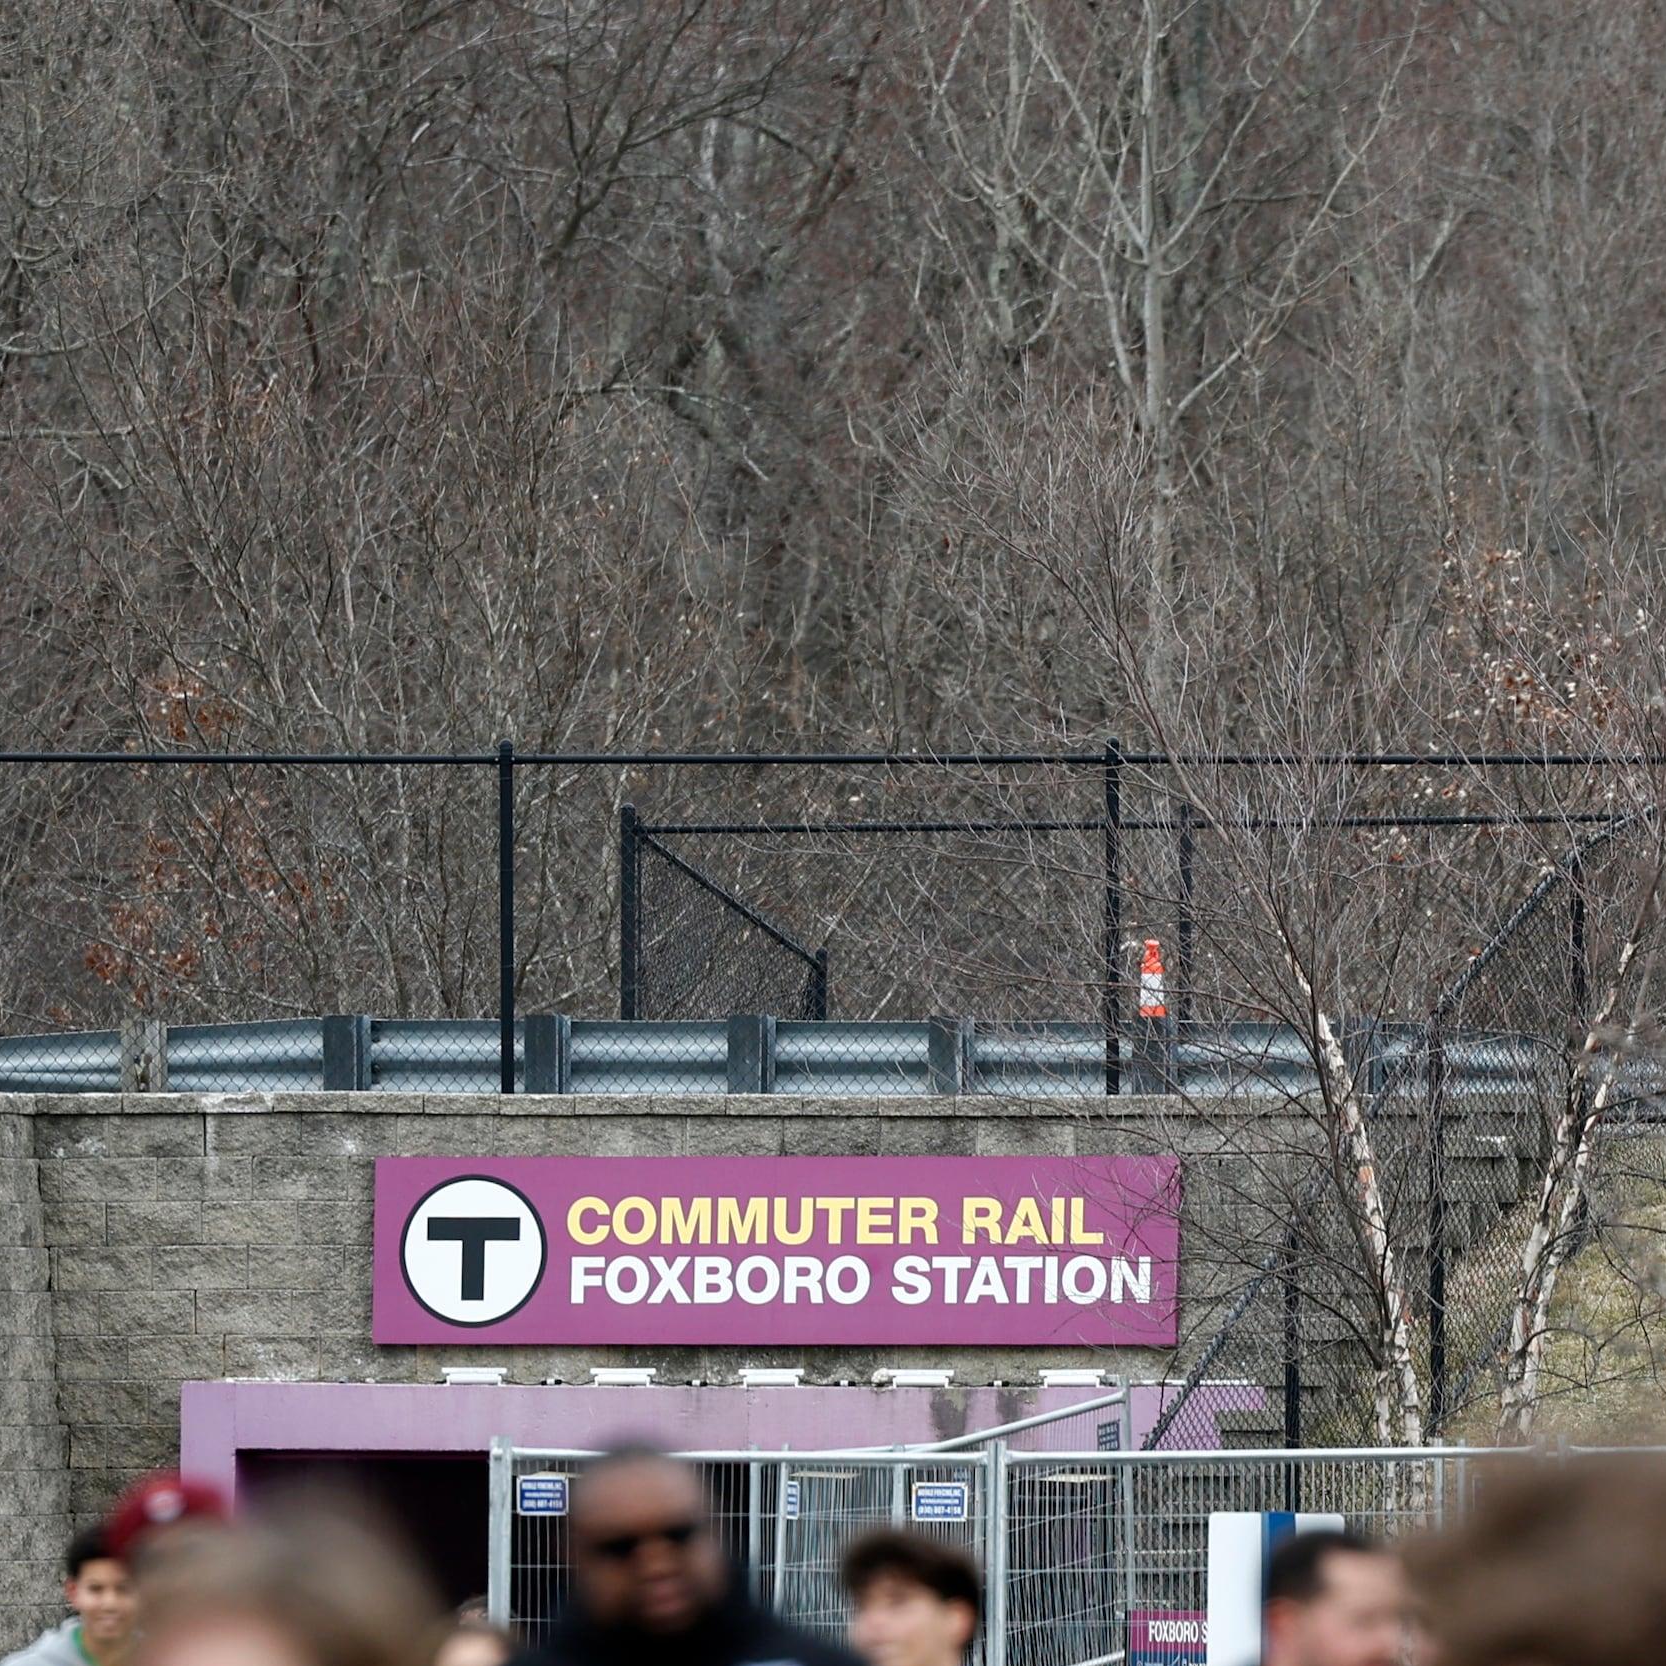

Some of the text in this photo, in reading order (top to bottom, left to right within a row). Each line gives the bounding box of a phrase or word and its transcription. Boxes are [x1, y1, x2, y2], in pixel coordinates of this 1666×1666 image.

[566, 1196, 1104, 1246] COMMUTER RAIL
[427, 1216, 521, 1301] T
[570, 1255, 1152, 1305] FOXBORO STATION
[1148, 1620, 1199, 1643] FOXBORO
